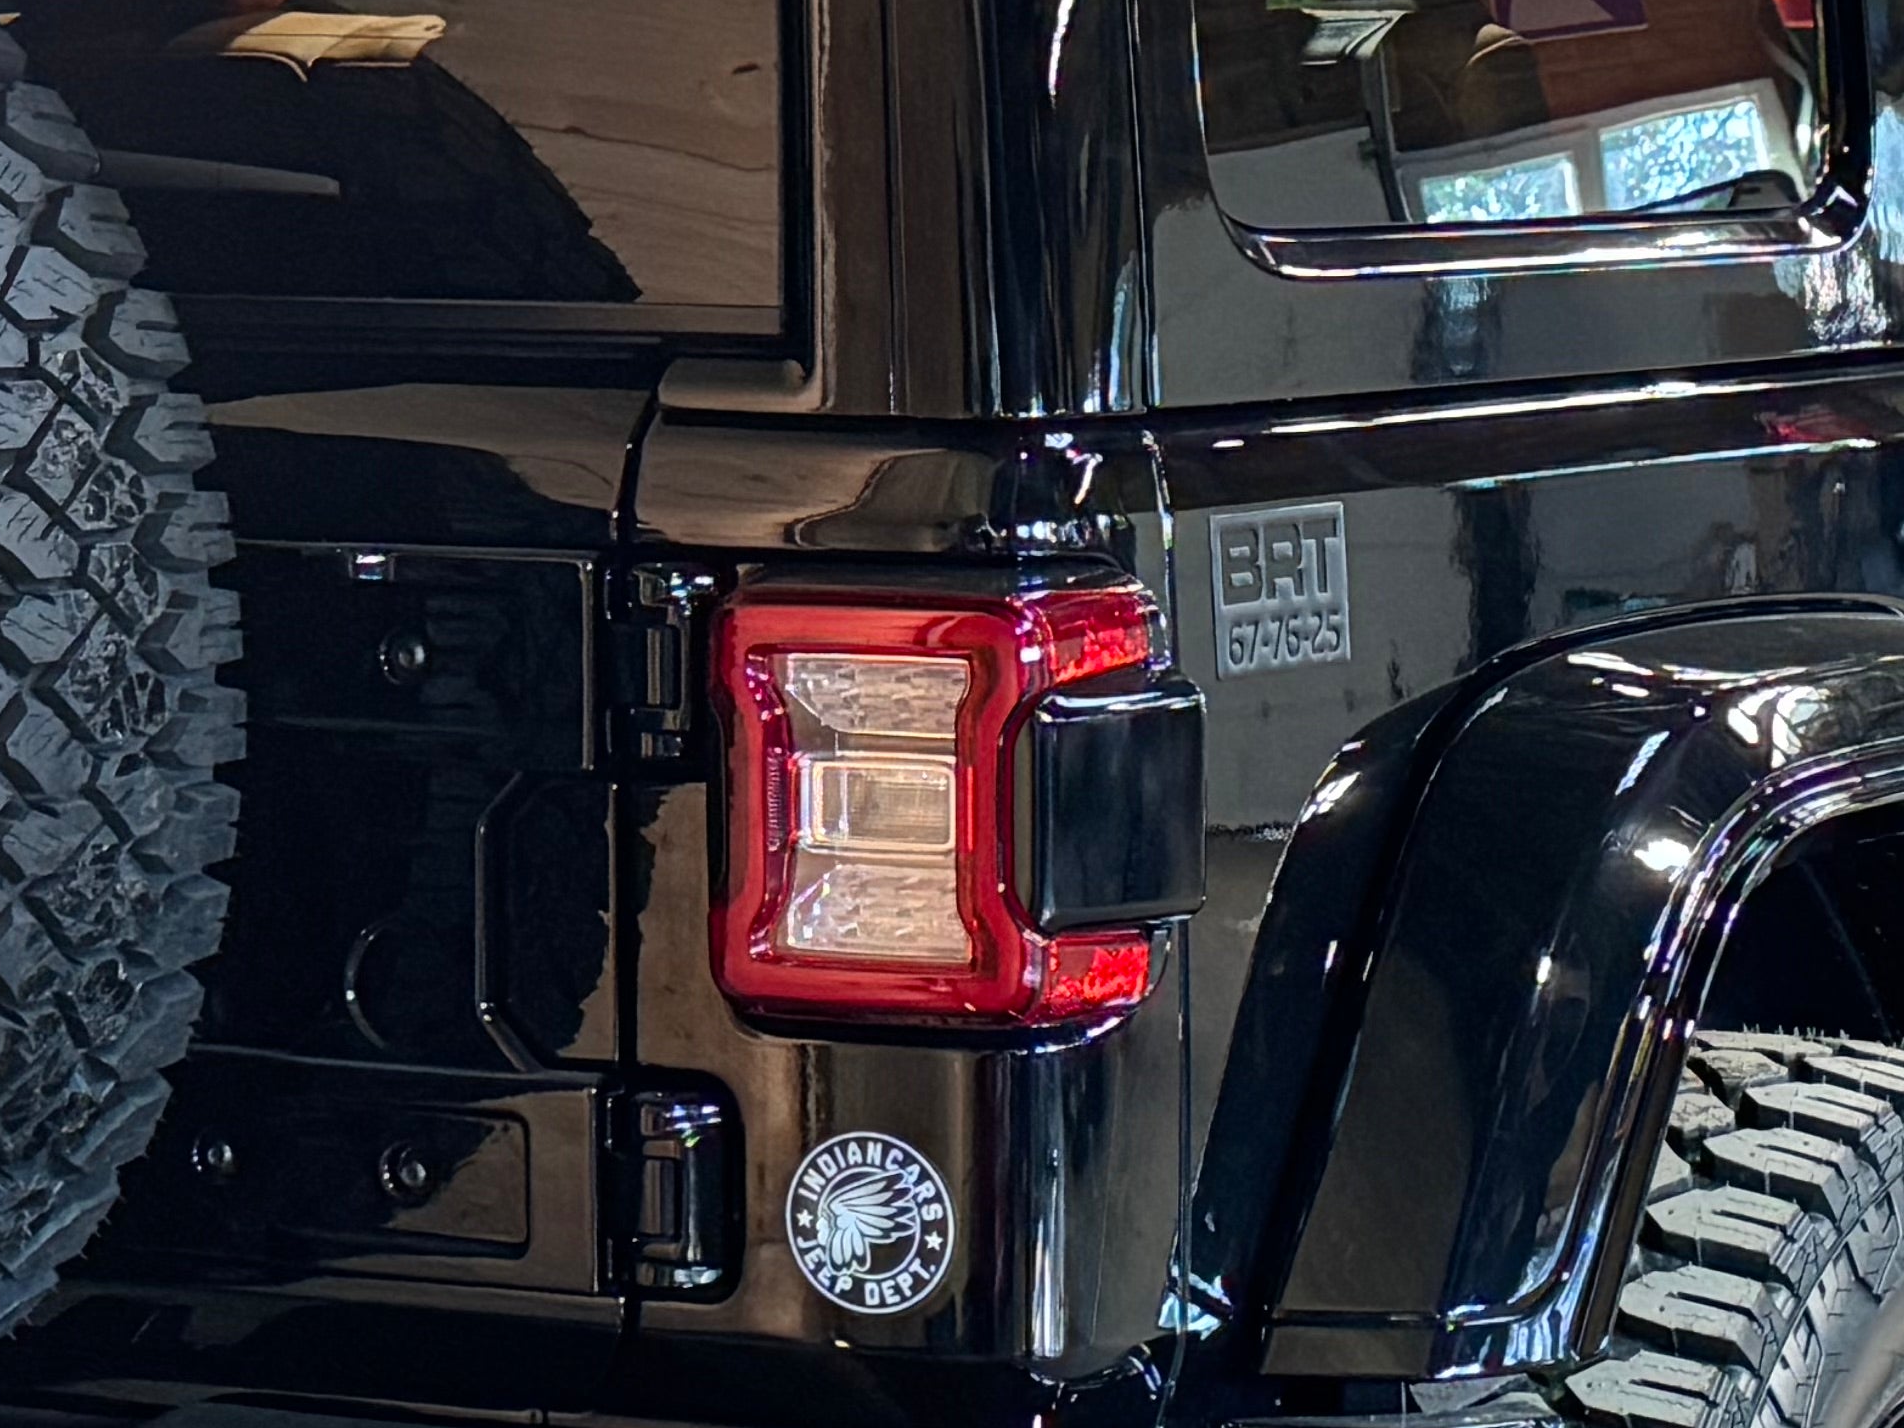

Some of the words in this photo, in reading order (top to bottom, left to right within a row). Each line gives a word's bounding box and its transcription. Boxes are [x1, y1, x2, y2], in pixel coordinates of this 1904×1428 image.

[1220, 517, 1338, 606] BRT
[798, 1140, 944, 1222] INDIANCARS
[797, 1236, 853, 1294] JEEP
[864, 1257, 937, 1306] DEPT.
